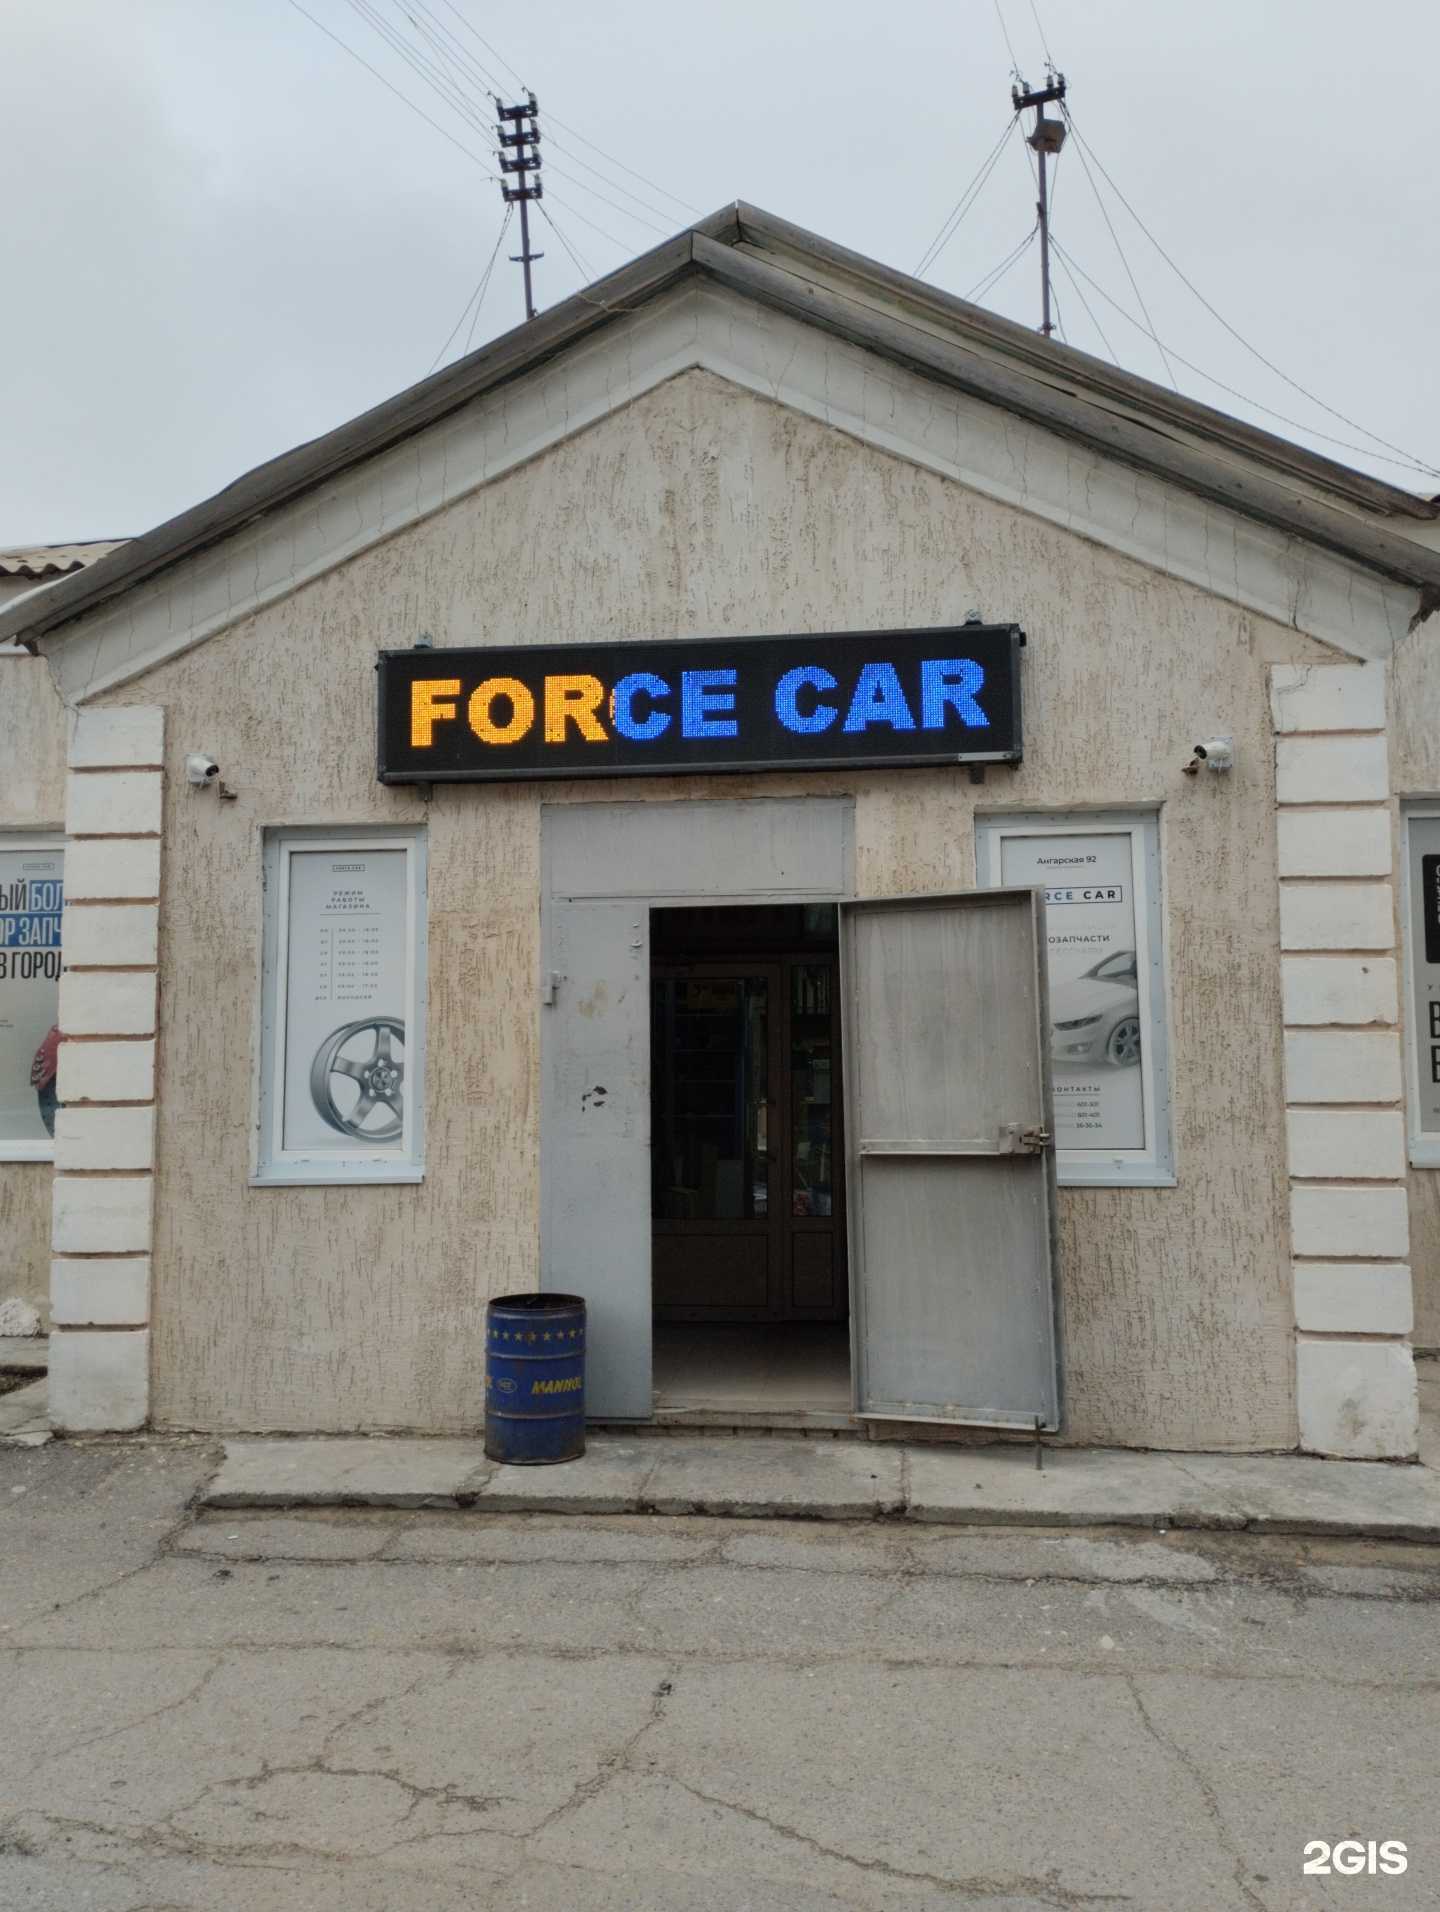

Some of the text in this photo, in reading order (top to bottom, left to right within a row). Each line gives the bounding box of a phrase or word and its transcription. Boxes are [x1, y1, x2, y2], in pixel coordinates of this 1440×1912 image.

[410, 658, 991, 748] FORCE CAR
[1036, 855, 1097, 866] Ангарская 92
[1083, 890, 1116, 900] CAR
[531, 1376, 582, 1395] MANNOL
